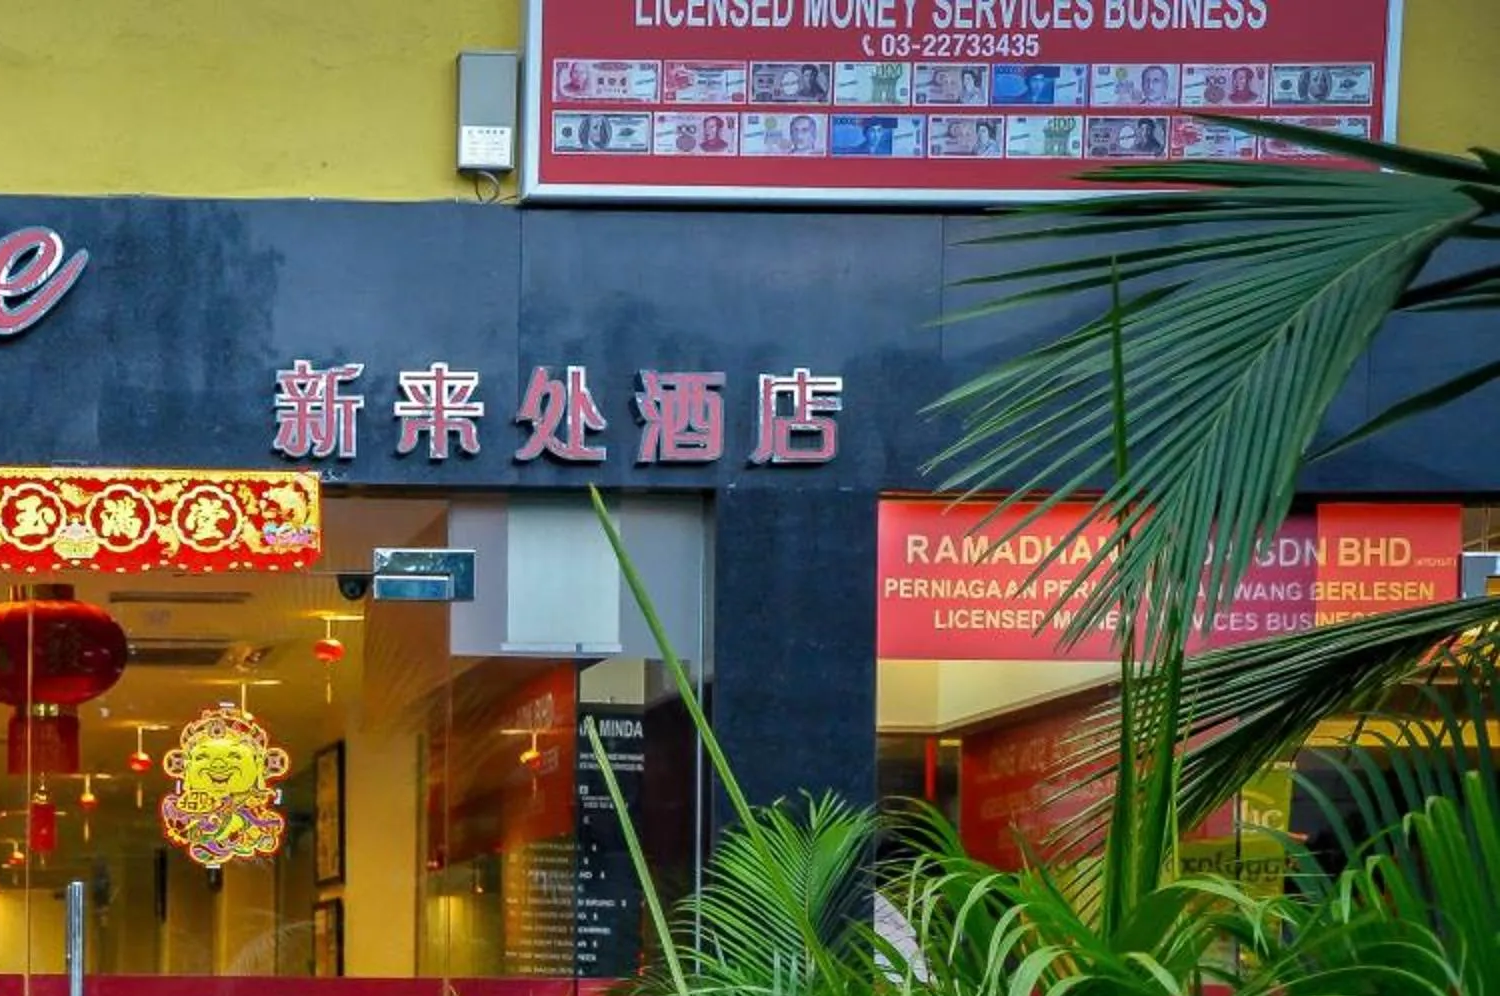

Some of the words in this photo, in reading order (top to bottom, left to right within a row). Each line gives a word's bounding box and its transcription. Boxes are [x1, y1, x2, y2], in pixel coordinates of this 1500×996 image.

[635, 0, 793, 27] LICENSED
[803, 0, 917, 28] MONEY
[932, 0, 1094, 29] SERVICES
[1104, 0, 1268, 30] BUSINESS
[880, 33, 1040, 57] 03-22733435
[1338, 537, 1411, 567] BHD
[884, 578, 1038, 600] PERNIAGAAN
[1234, 581, 1302, 601] WANG
[1313, 581, 1435, 601] BERLESEN
[933, 609, 1045, 629] LICENSED
